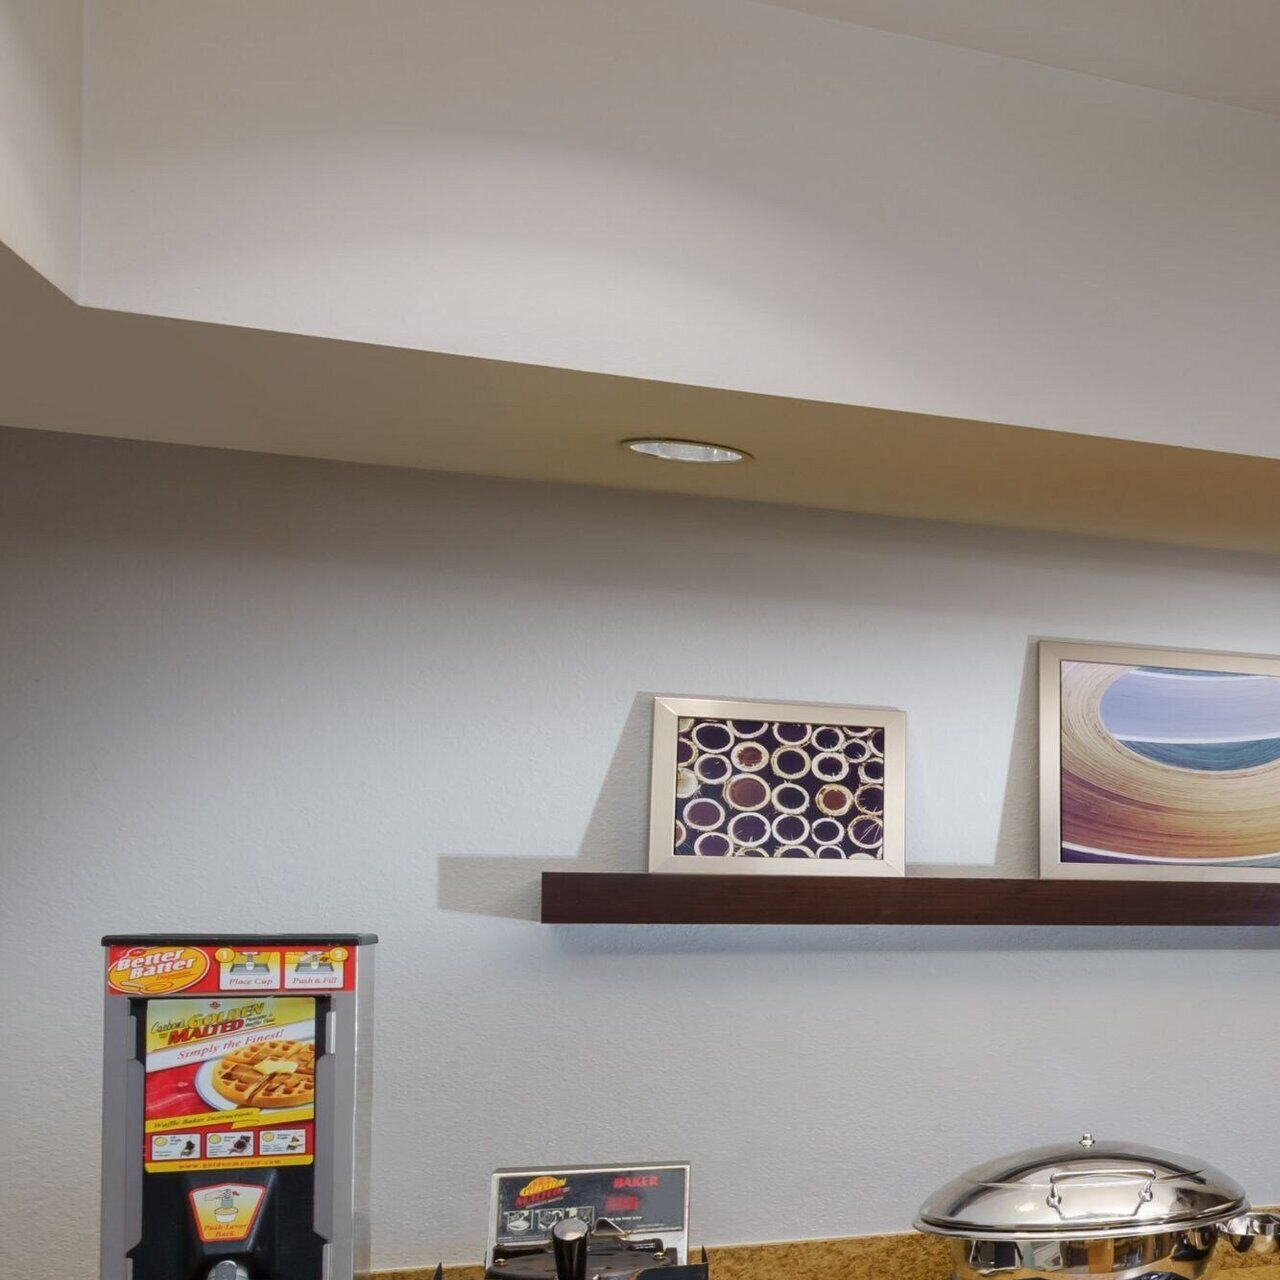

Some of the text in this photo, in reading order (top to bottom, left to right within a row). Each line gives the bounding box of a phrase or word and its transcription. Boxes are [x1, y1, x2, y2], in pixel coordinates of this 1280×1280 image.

[116, 949, 184, 971] Better
[129, 958, 196, 980] Batter
[229, 977, 273, 986] Place Cup
[292, 976, 313, 984] Push
[322, 976, 338, 984] Fill
[187, 1002, 265, 1027] GOLDEN
[168, 1019, 245, 1045] MALTED
[177, 1029, 285, 1060] Simply the Finest!
[613, 1175, 659, 1188] BAKER
